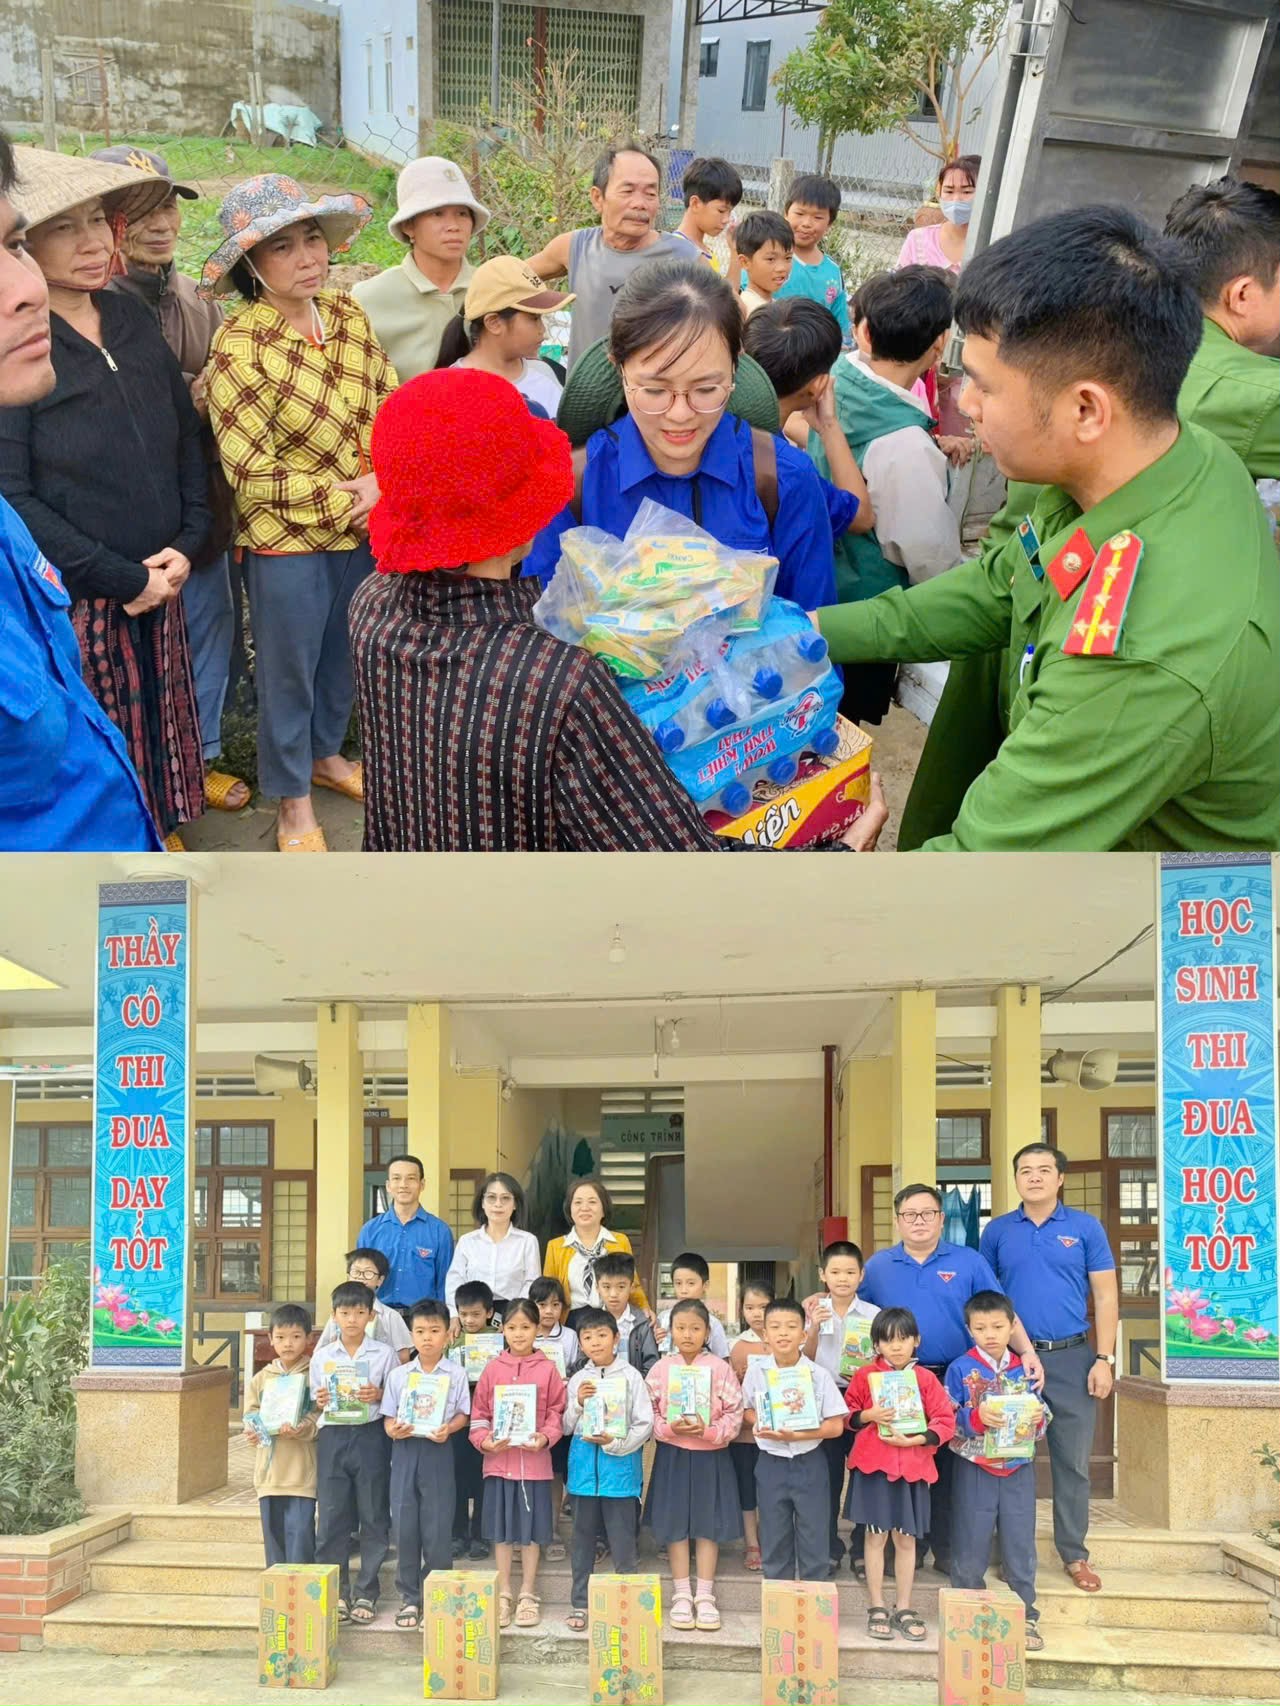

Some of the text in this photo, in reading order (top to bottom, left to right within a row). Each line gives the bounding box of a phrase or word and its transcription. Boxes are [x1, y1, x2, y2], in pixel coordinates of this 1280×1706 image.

[104, 917, 182, 969] THẦY
[1179, 897, 1253, 947] HỌC
[1176, 965, 1259, 1004] SINH
[121, 985, 162, 1028] CÔ
[115, 1055, 166, 1089] THI
[1186, 1032, 1248, 1070] THI
[111, 1115, 170, 1150] ĐUA
[621, 1130, 646, 1143] CÔNG
[1182, 1100, 1256, 1138] ĐUA
[110, 1175, 169, 1218] DẠY
[1181, 1165, 1257, 1214] HỌC
[110, 1222, 167, 1271] TỐT
[1184, 1215, 1256, 1273] TỐT
